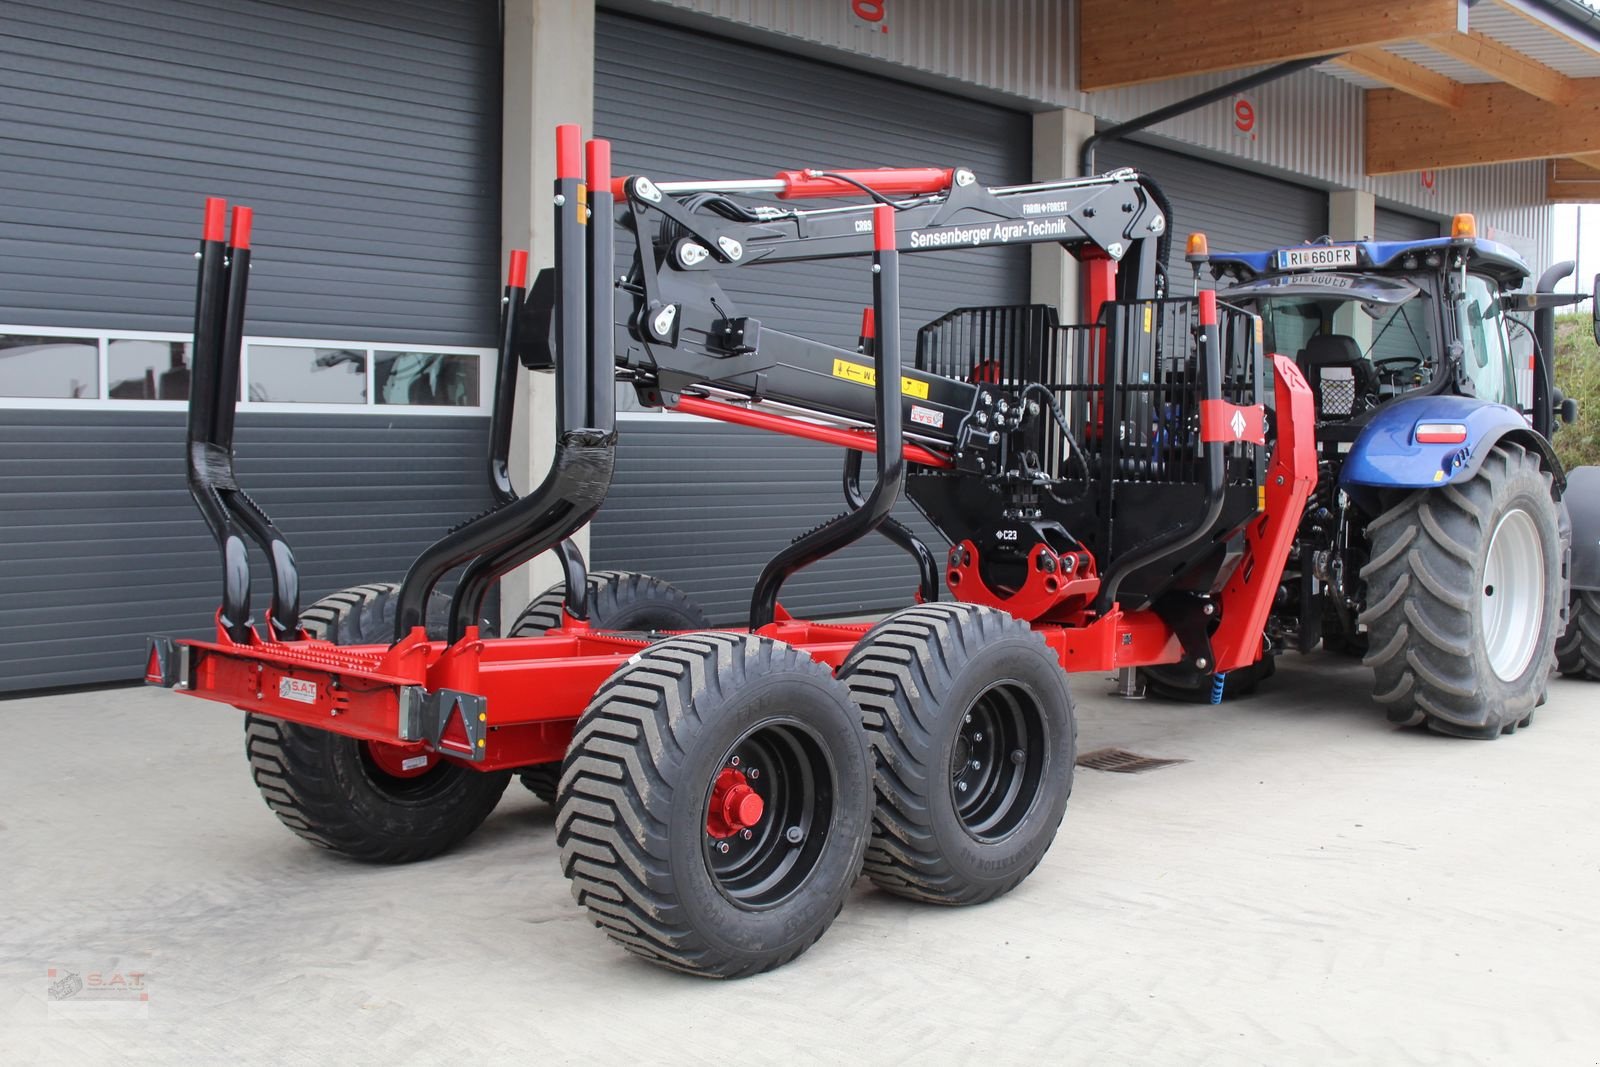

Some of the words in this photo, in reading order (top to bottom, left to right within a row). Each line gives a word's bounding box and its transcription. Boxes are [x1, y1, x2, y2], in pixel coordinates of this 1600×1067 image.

[1047, 201, 1068, 213] FOREST
[910, 227, 992, 248] Sensenberger
[993, 219, 1067, 242] Agrar-Technik
[1291, 252, 1302, 265] RI
[1003, 530, 1017, 540] C23
